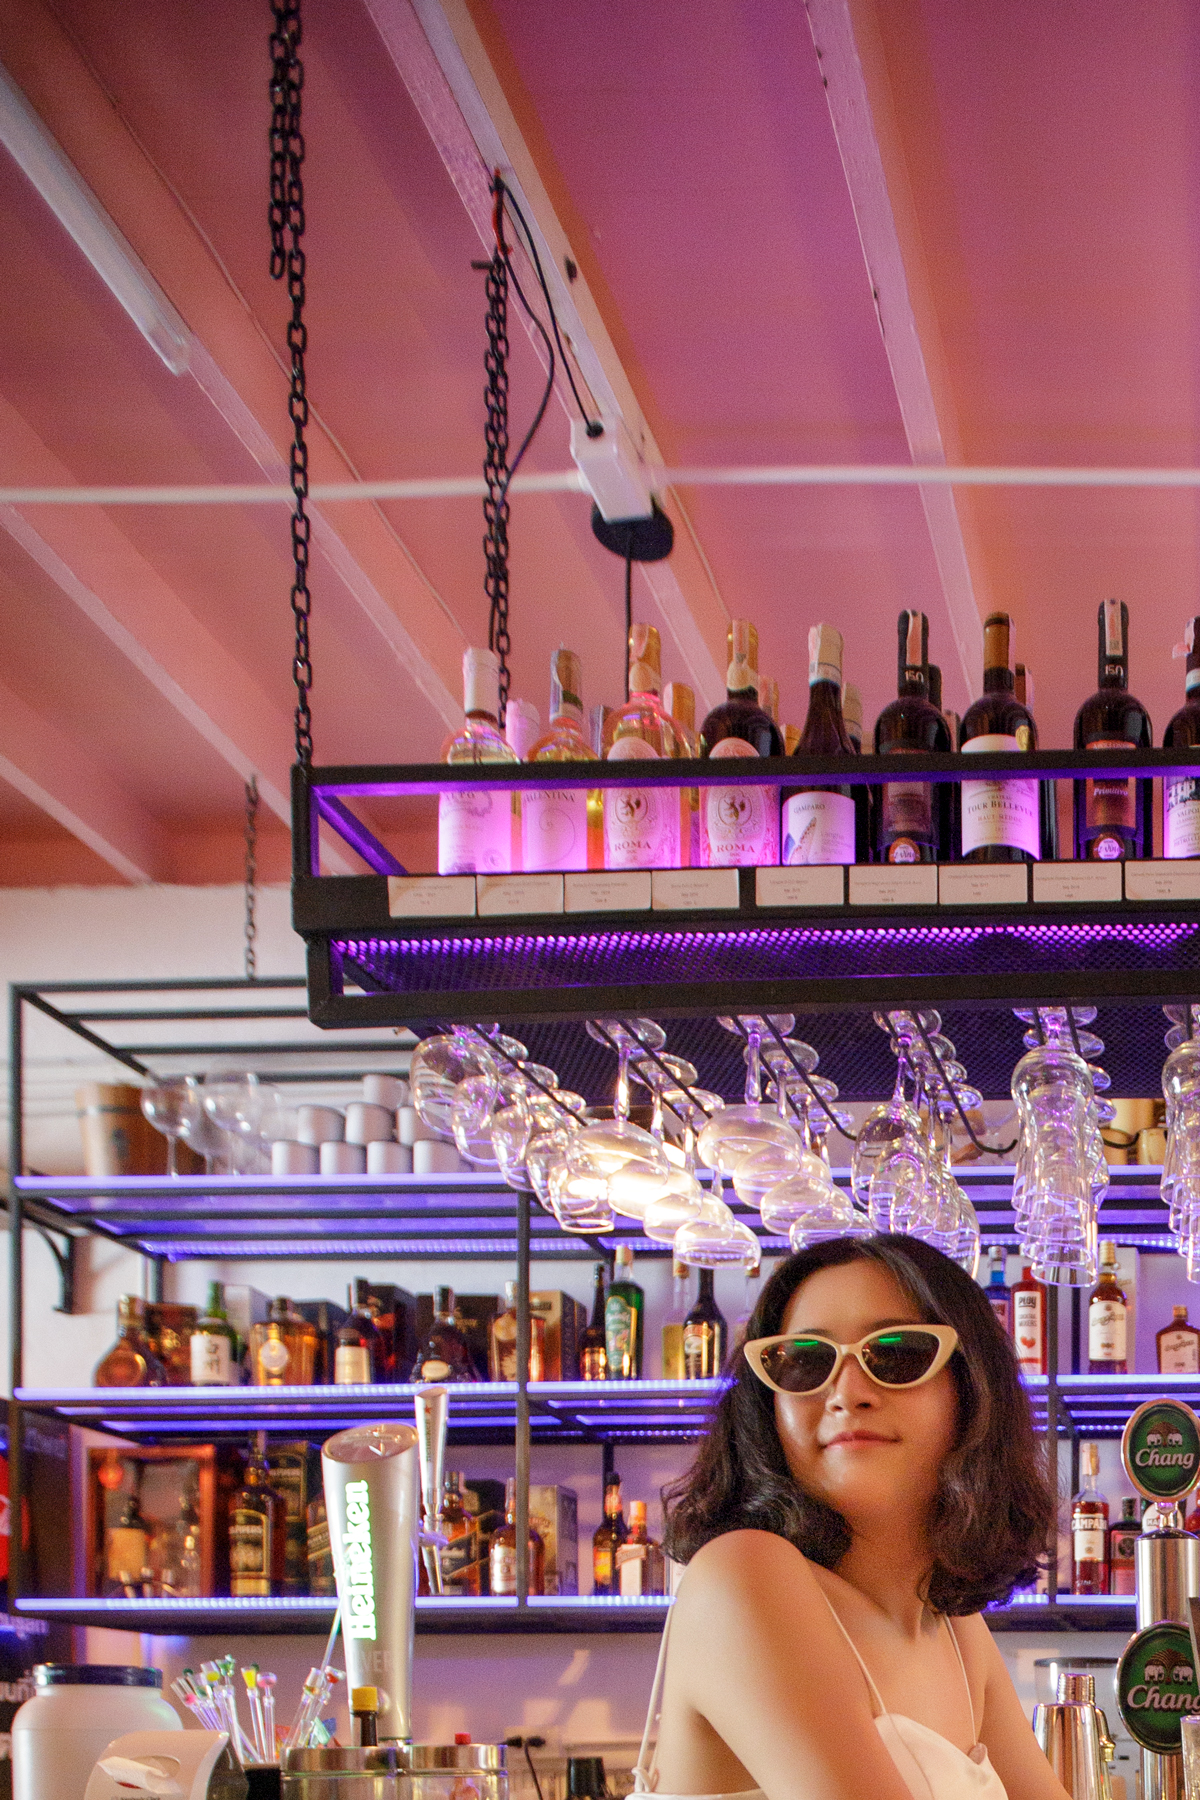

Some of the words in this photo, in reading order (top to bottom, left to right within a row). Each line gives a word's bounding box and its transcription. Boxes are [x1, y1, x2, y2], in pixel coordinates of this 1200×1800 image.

[1094, 787, 1129, 796] Primitivo
[968, 802, 988, 814] TOUR
[614, 841, 652, 851] ROMA
[716, 843, 755, 853] ROMA
[1135, 1449, 1195, 1470] Chang
[1072, 1518, 1107, 1530] CAMPARI
[342, 1479, 377, 1642] Heineken
